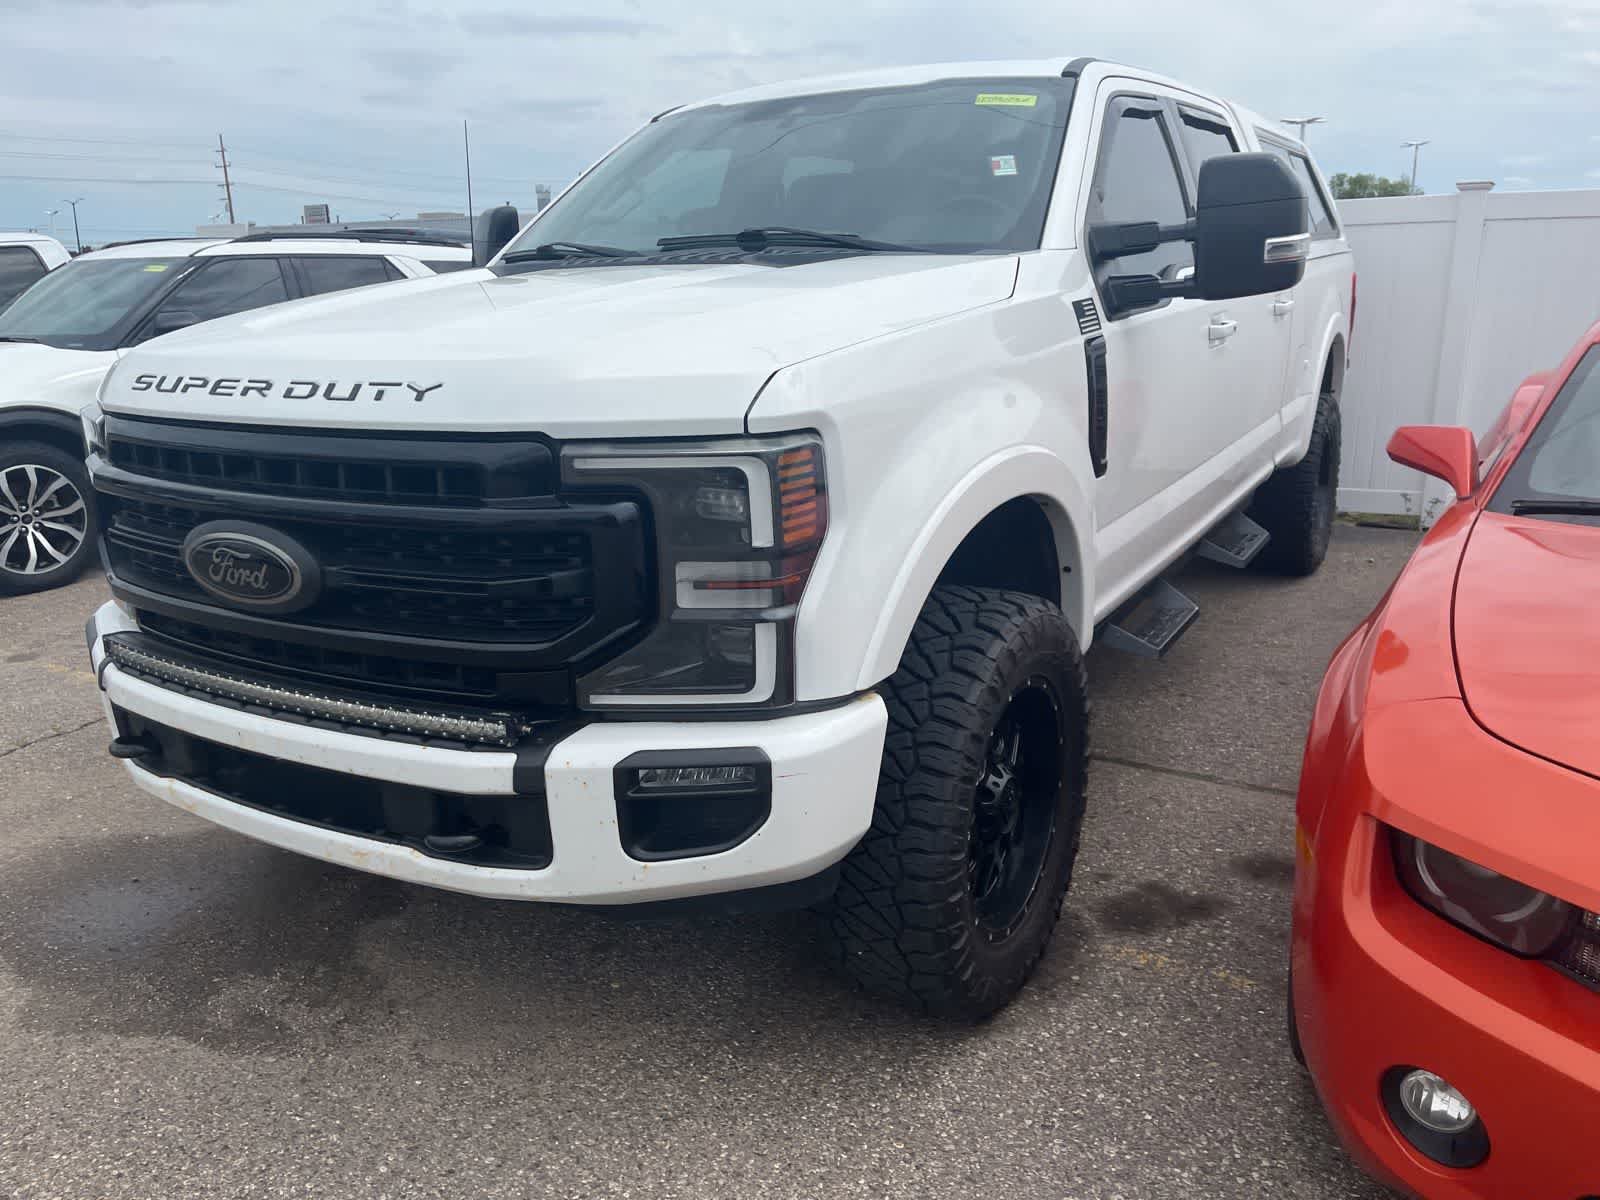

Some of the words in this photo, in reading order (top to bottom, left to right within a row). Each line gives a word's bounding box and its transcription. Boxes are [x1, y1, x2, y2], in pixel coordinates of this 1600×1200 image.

[131, 374, 274, 397] SUPER
[282, 381, 444, 401] DUTY
[208, 547, 270, 590] Ford
